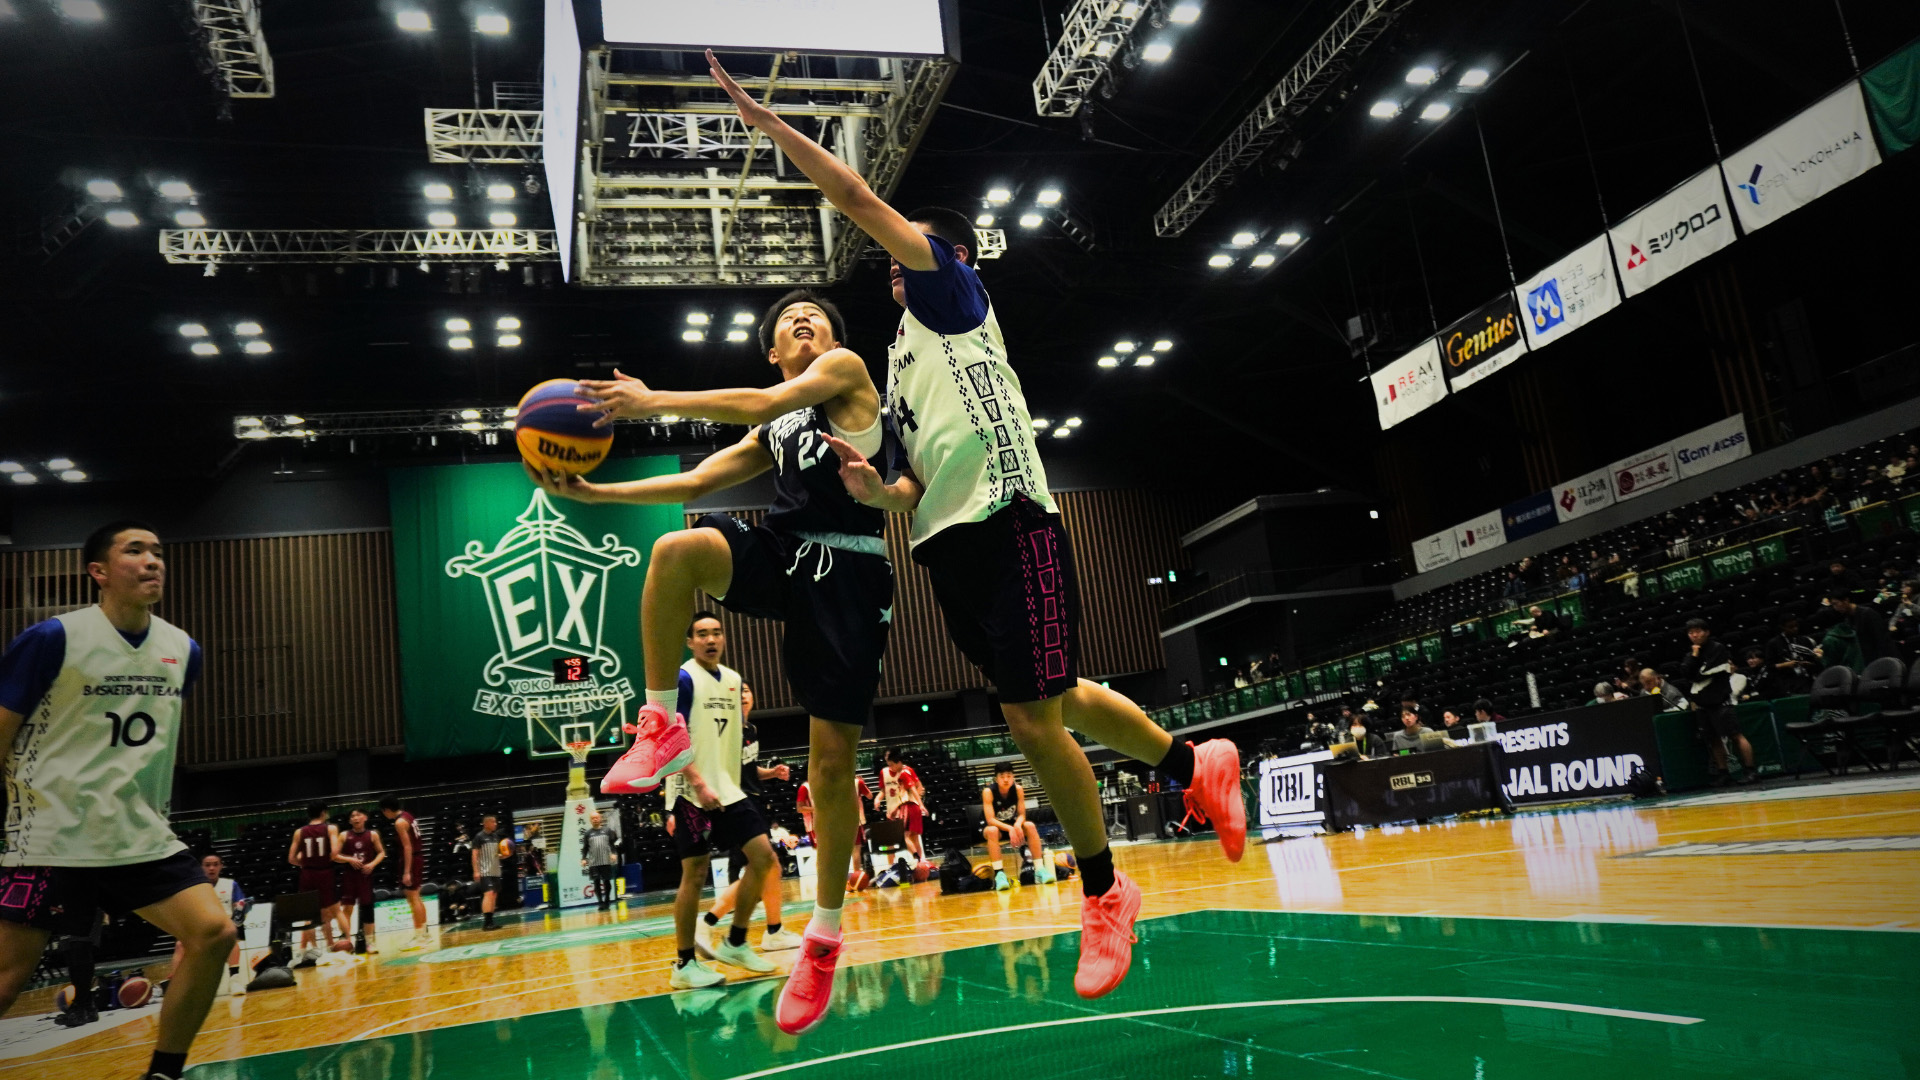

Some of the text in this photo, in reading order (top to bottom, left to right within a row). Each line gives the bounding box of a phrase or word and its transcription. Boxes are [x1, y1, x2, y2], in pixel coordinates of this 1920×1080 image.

[1648, 203, 1722, 255] ミツウロコ
[1446, 312, 1515, 367] Genius
[538, 436, 602, 463] Wilson
[1712, 543, 1777, 568] PENATY
[493, 561, 599, 653] EX
[567, 666, 582, 681] 12
[83, 684, 182, 697] BASKETBALL TEAM
[473, 678, 636, 717] EXCELLENCE
[104, 711, 156, 748] 10
[713, 717, 728, 738] 17
[1270, 771, 1311, 803] RBL
[1390, 776, 1414, 790] RBL
[303, 837, 325, 858] 11
